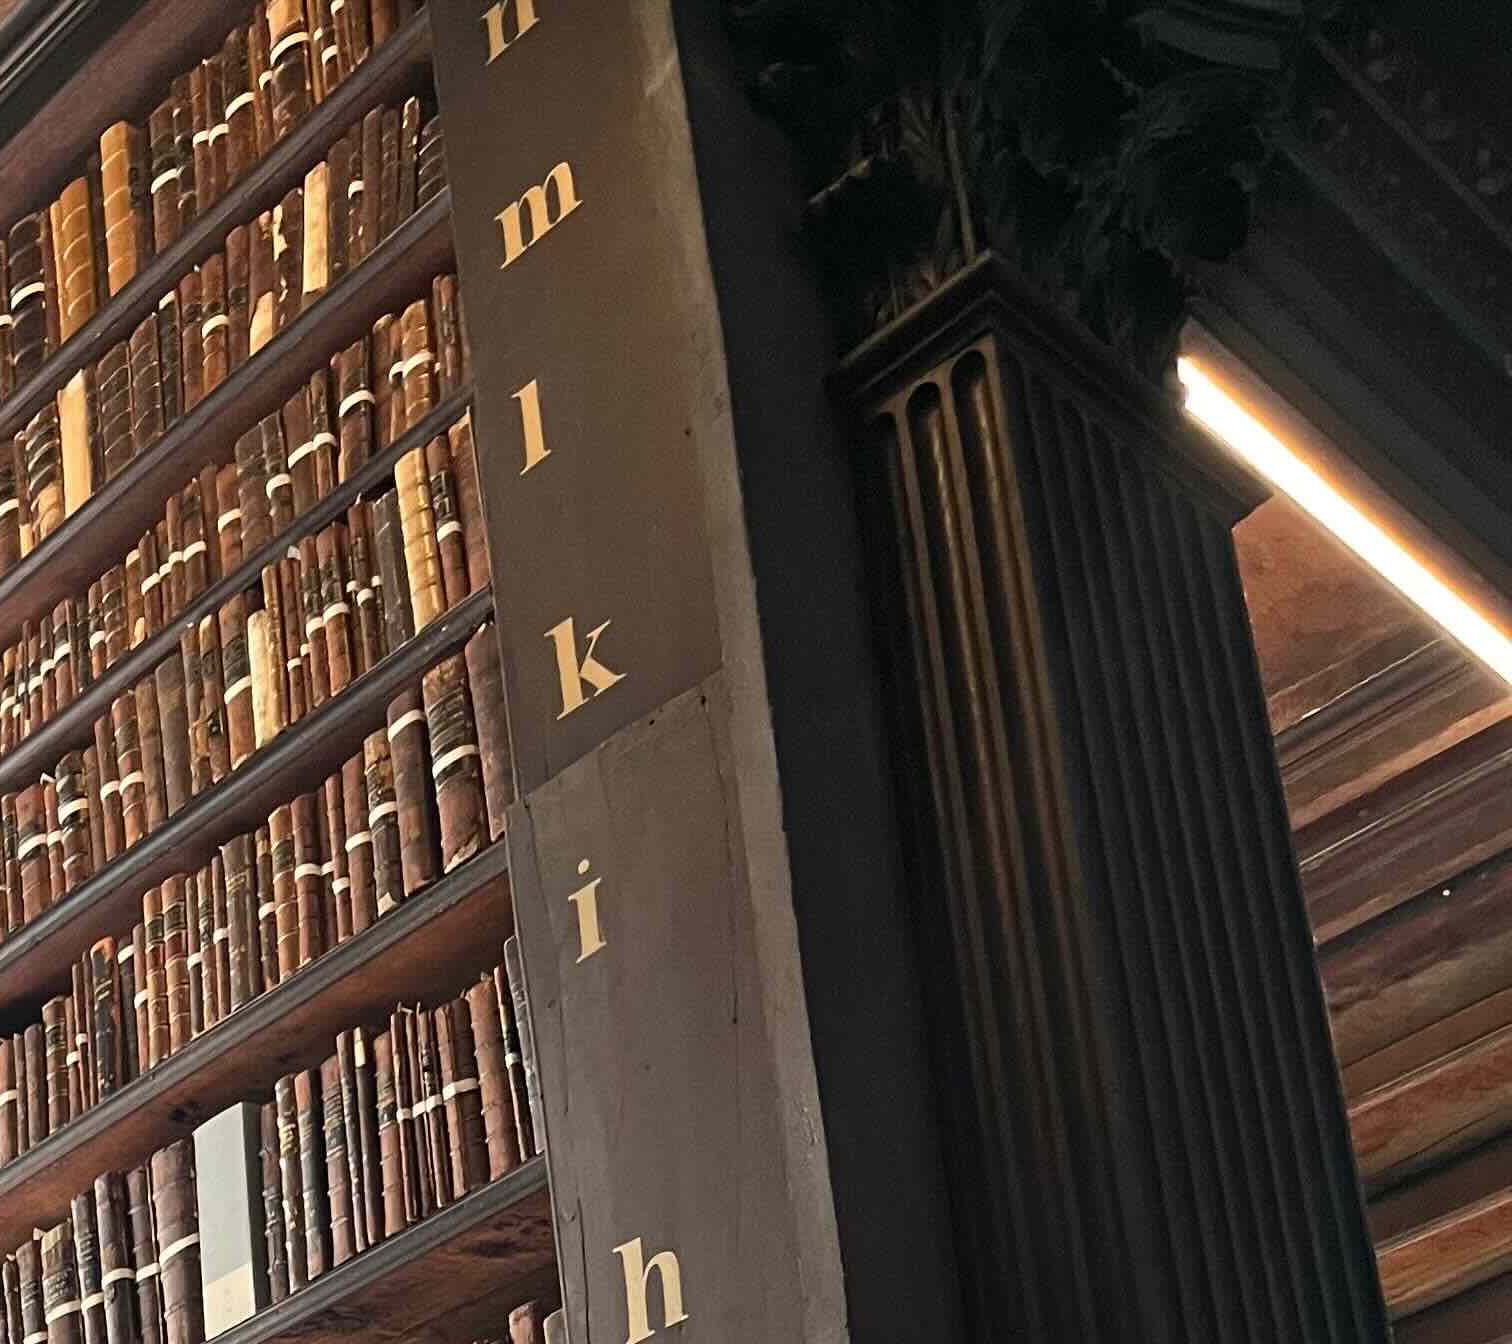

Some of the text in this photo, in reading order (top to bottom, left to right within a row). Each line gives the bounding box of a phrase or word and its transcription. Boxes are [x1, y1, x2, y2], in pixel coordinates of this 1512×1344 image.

[494, 160, 583, 270] m
[511, 378, 552, 476] l
[543, 616, 628, 722] k
[567, 859, 607, 964] i
